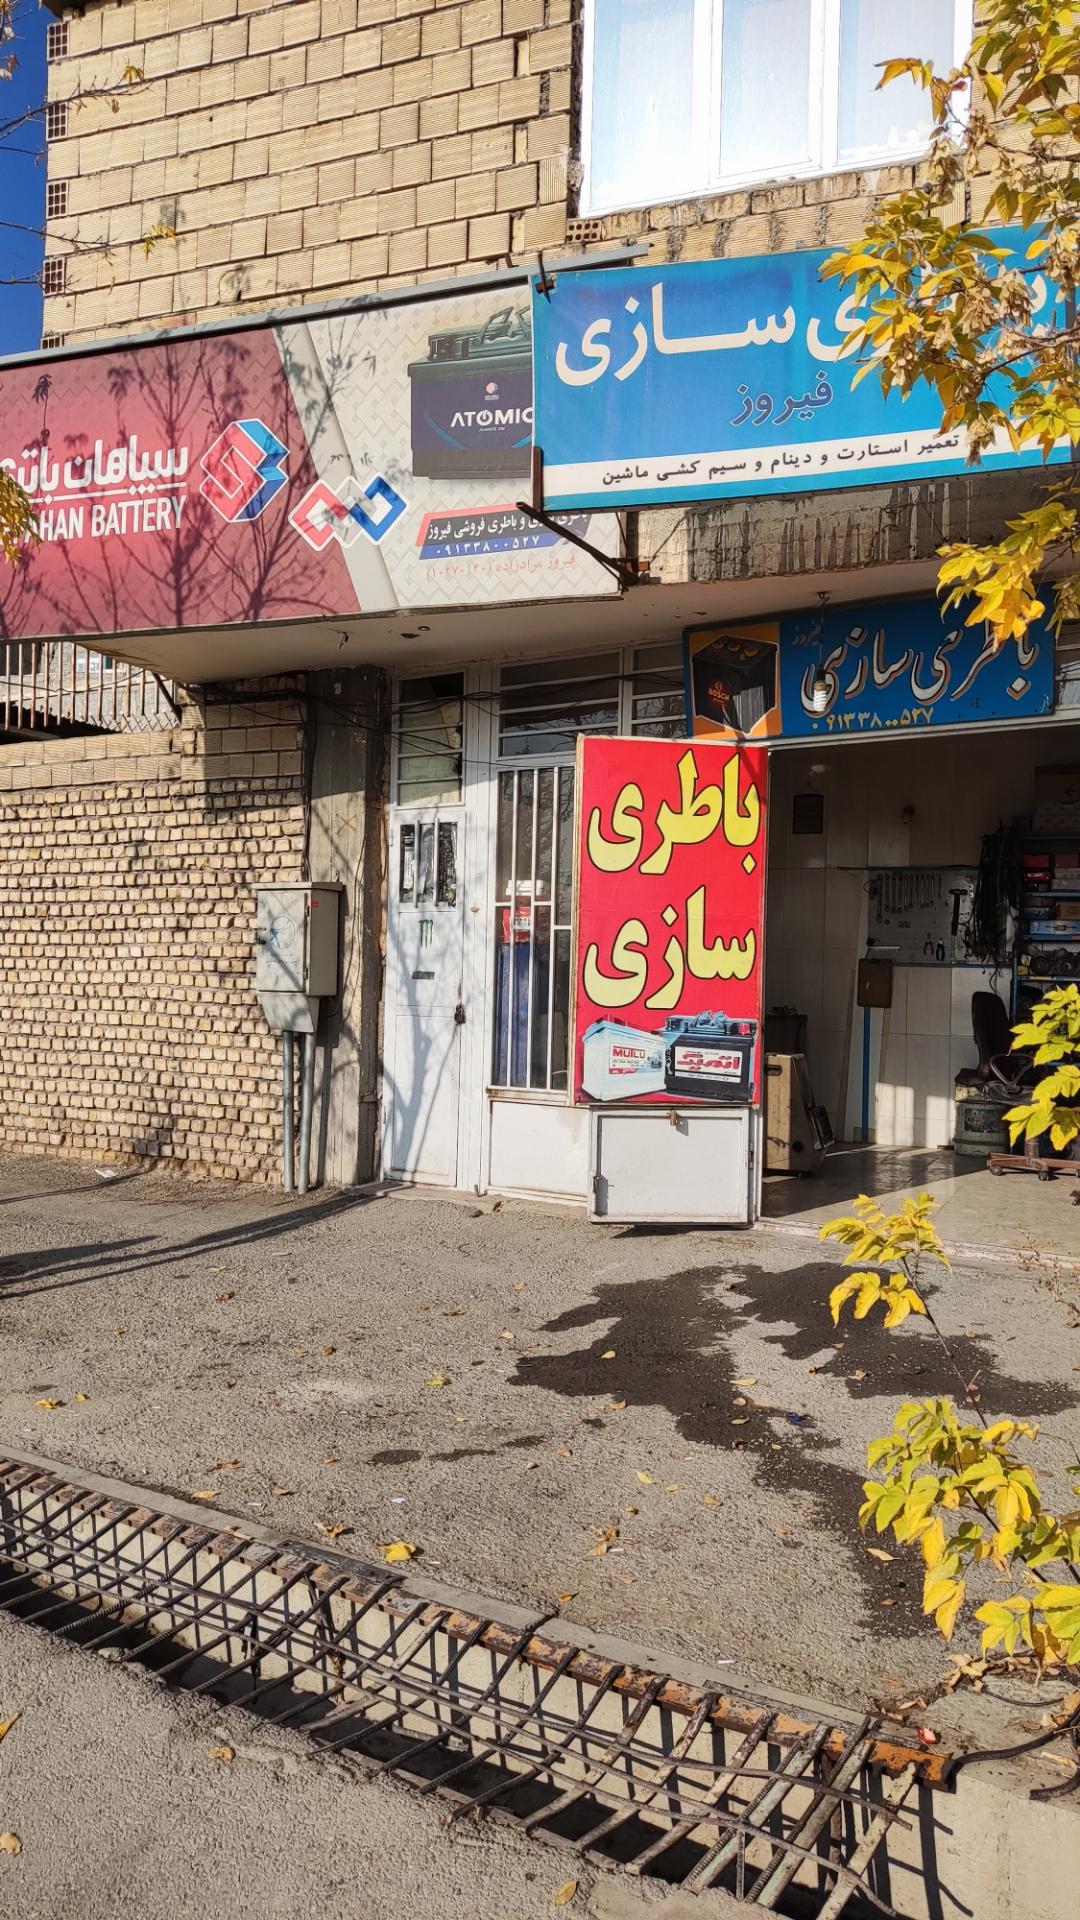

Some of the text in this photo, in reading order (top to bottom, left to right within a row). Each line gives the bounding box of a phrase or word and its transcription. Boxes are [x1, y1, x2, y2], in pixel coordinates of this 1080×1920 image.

[556, 282, 796, 386] سازی
[450, 406, 534, 428] ATOMIC
[729, 369, 834, 427] فیروز
[64, 434, 189, 495] سپاهان
[602, 434, 960, 485] تعمیر استارت و دینام و سیم کشی ماشین
[91, 495, 187, 538] BATTERY
[427, 520, 452, 541] فیروز
[453, 517, 486, 539] فروشی
[487, 514, 518, 535] باطری
[708, 687, 731, 702] BOSCH
[800, 625, 914, 719] سازی
[586, 747, 761, 876] باطری
[582, 884, 757, 1011] سازی
